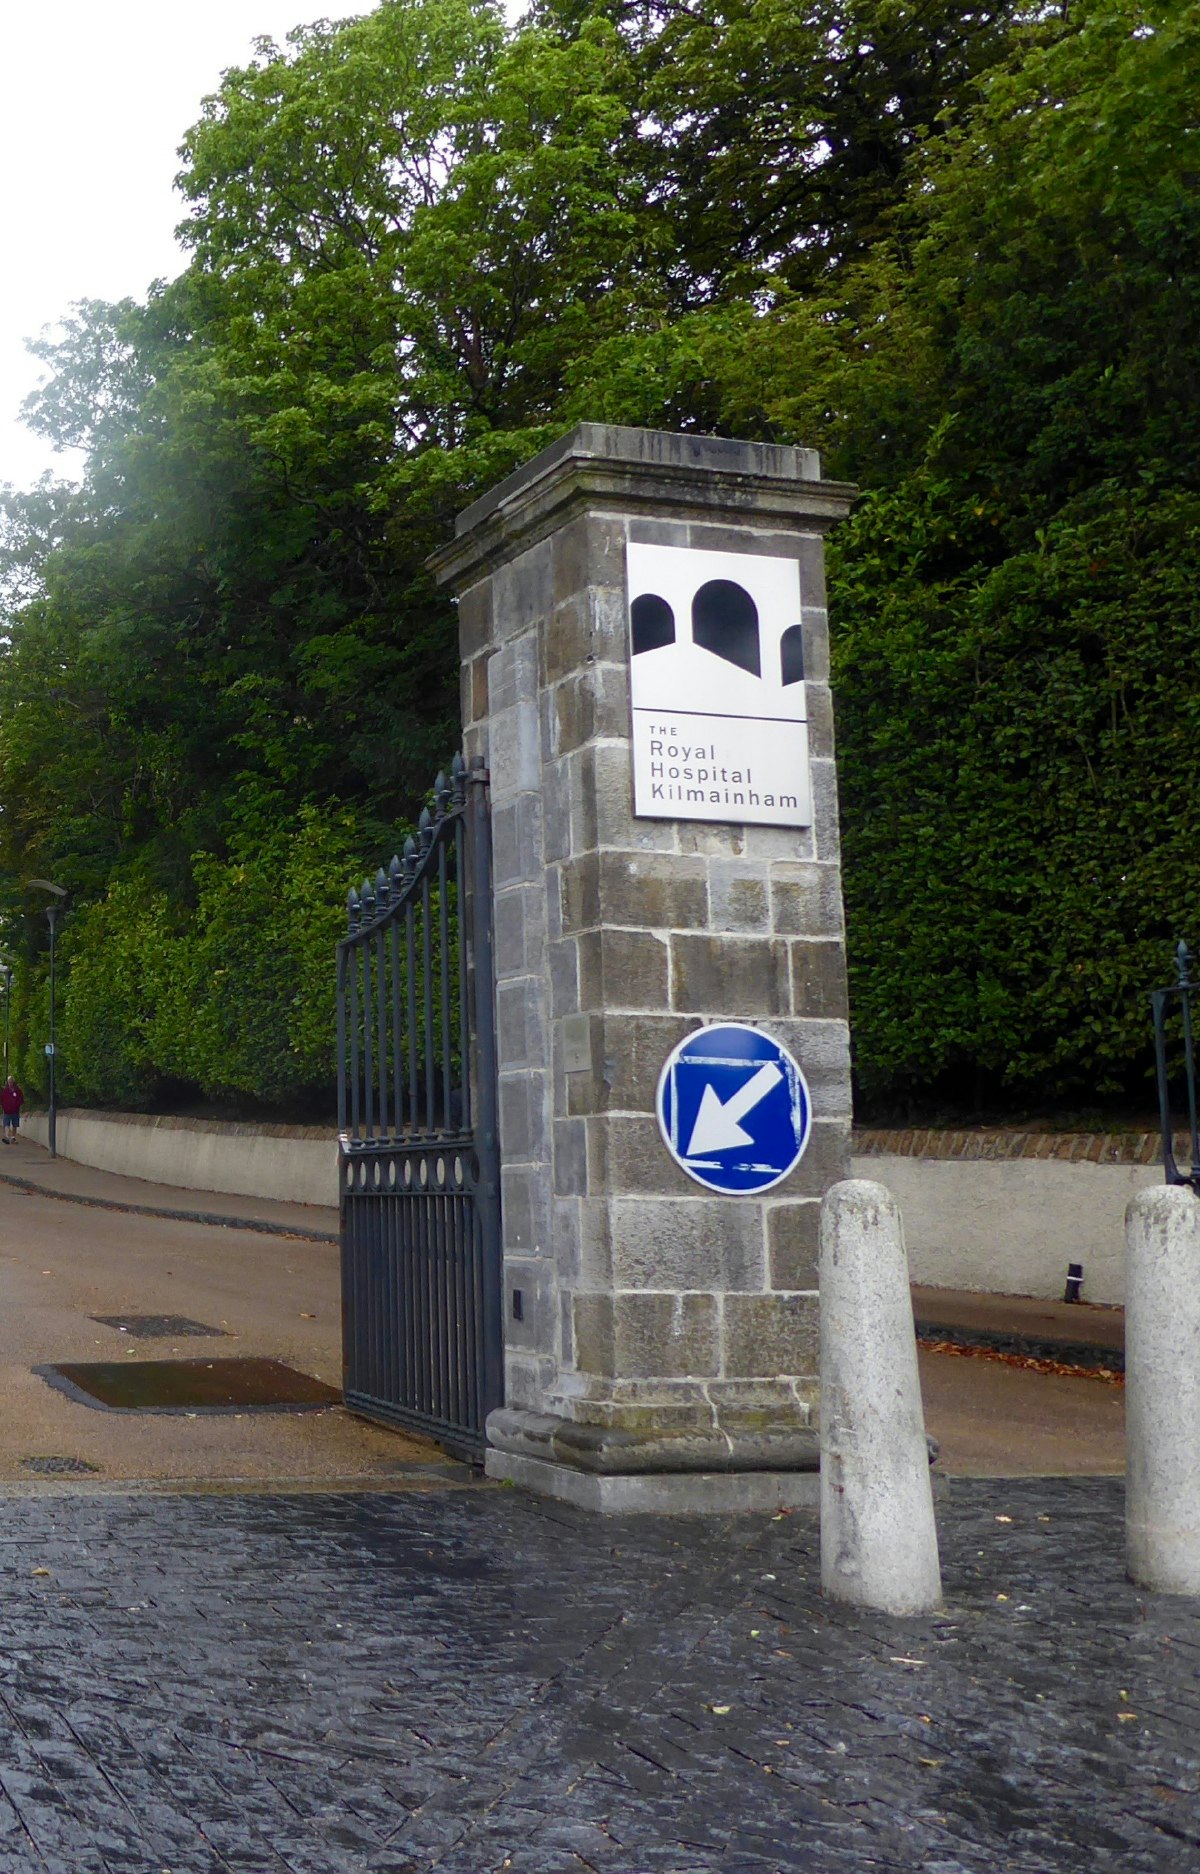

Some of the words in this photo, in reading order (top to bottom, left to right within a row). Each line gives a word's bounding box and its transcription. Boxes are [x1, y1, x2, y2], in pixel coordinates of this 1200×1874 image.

[649, 725, 678, 737] THE
[650, 740, 715, 762] Royal
[651, 761, 751, 784] Hospital
[652, 783, 798, 809] Kilmainham
